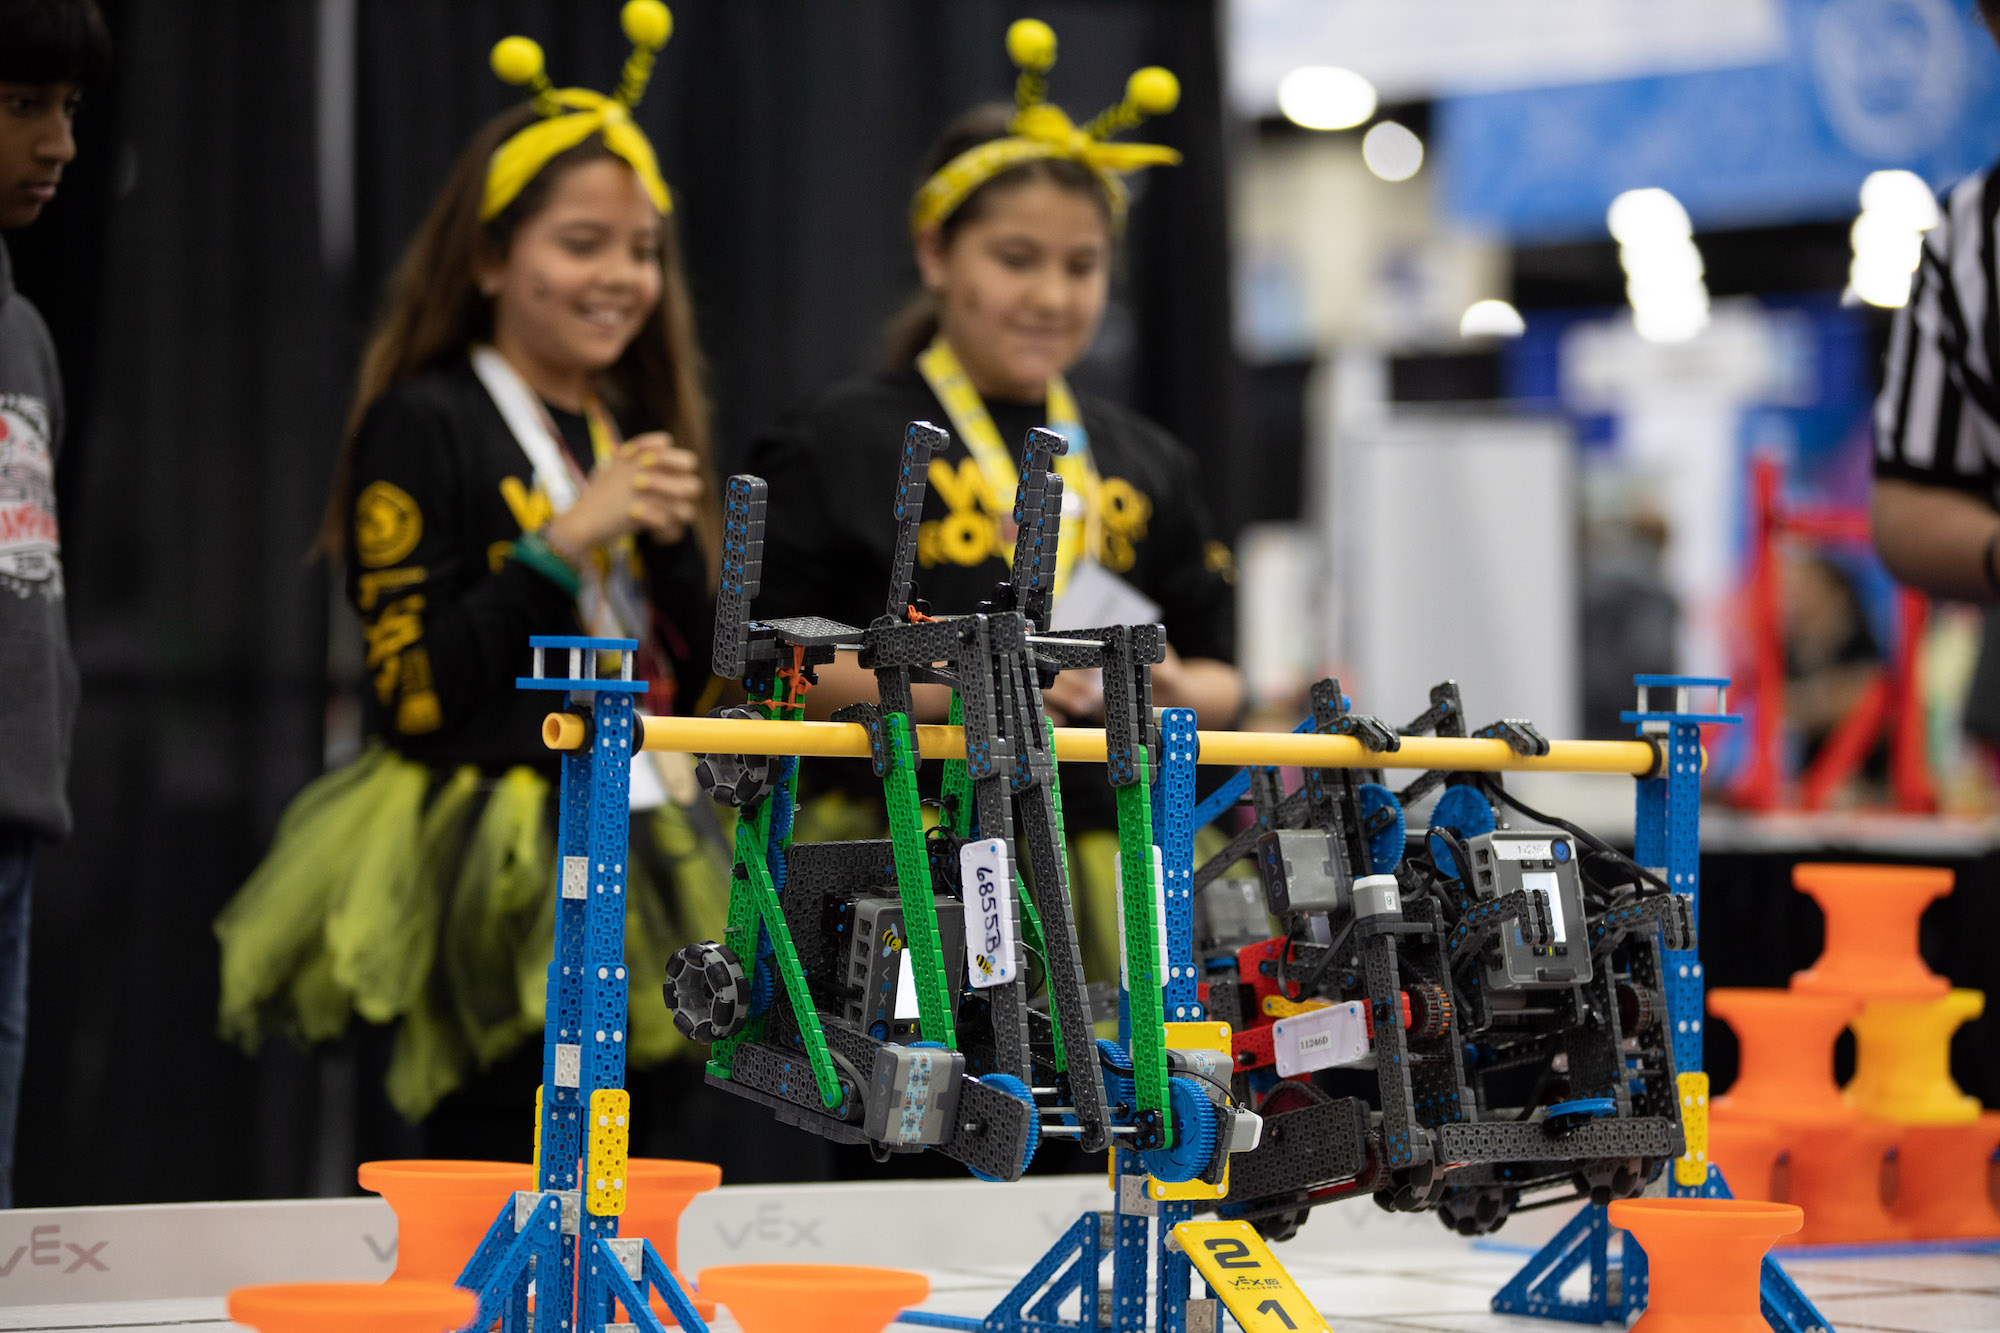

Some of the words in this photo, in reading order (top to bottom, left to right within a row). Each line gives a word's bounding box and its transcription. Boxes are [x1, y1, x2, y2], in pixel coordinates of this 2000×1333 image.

[976, 867, 1001, 953] 6855B
[879, 965, 891, 1006] VEX
[1300, 1036, 1329, 1050] 11246D
[714, 1202, 824, 1251] VEX
[1203, 1238, 1262, 1269] 2
[1227, 1276, 1265, 1287] VEX
[1256, 1299, 1299, 1330] 1
